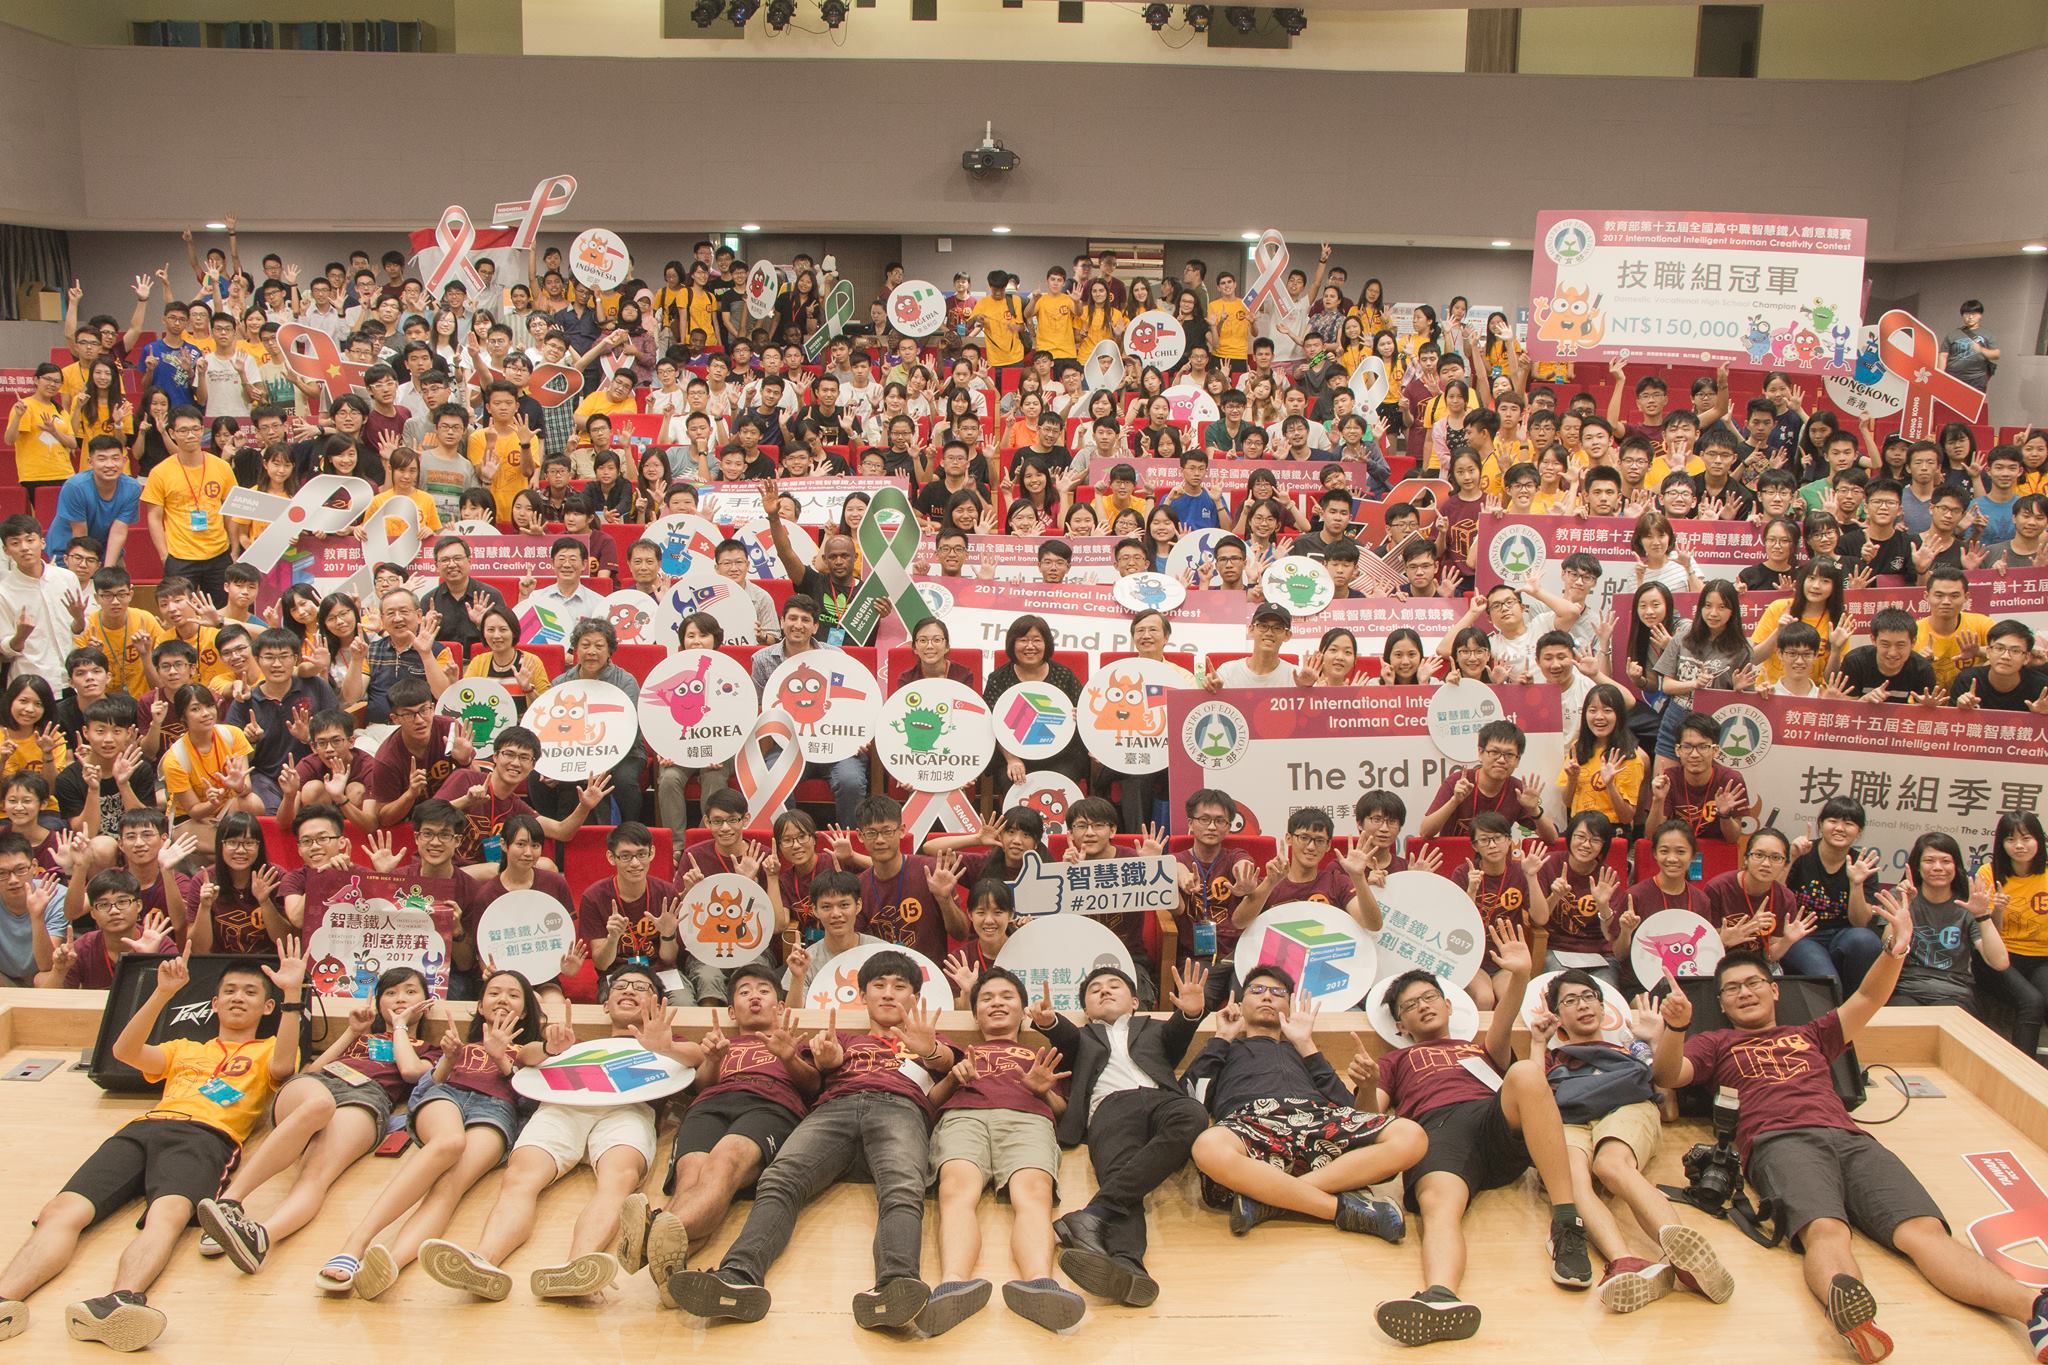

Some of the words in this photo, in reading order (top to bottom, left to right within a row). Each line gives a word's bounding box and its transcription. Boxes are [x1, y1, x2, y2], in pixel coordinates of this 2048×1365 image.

[1603, 234, 1623, 242] 2017
[1626, 234, 1681, 245] International
[1684, 236, 1727, 247] Intelligent
[1730, 238, 1767, 248] Ironman
[1770, 239, 1813, 250] Creativity
[1816, 241, 1851, 251] Contest
[1617, 260, 1799, 295] 技職組冠軍
[1752, 300, 1797, 312] Champion
[1612, 316, 1739, 338] NT$150,000
[509, 452, 521, 465] 15
[206, 483, 218, 495] 15
[1555, 527, 1635, 543] 教育部第十五
[1675, 532, 1764, 547] 高中職智慧鐵人
[323, 548, 361, 560] 教育部
[473, 546, 549, 559] 智慧鐵人創意
[1555, 544, 1577, 554] 2017
[1580, 545, 1633, 556] Internation
[1734, 551, 1769, 560] Creativi
[323, 563, 345, 572] 2017
[405, 563, 436, 574] Intellig
[493, 562, 536, 573] Creativity
[974, 585, 1006, 594] 2017
[1009, 587, 1092, 600] International
[1024, 599, 1078, 611] Ironman
[1083, 601, 1135, 615] Creativi
[1162, 607, 1201, 618] ontest
[1990, 595, 2044, 608] ernational
[850, 597, 875, 628] NIGERIA
[863, 608, 874, 622] 2017
[1318, 607, 1455, 622] 中職智慧鐵人創意競賽
[1112, 634, 1199, 654] Plce
[201, 652, 215, 664] 15
[1271, 697, 1305, 711] 2017
[1309, 696, 1402, 710] International
[1329, 714, 1390, 729] Ironman
[1450, 722, 1484, 735] 創意競
[820, 723, 866, 737] CHILE
[1185, 707, 1203, 755] MINISTRY
[1203, 704, 1217, 713] OF
[1218, 704, 1247, 753] EDUCATION
[1730, 706, 1742, 716] OF
[1744, 708, 1770, 758] EDUCATION
[808, 741, 834, 755] 智利
[1125, 736, 1168, 749] TAIWA
[1783, 728, 1811, 740] 2017
[1814, 733, 1888, 747] International
[1891, 738, 1951, 752] Intelligent
[1954, 741, 2003, 755] Ironman
[541, 744, 620, 758] NDONESIA
[688, 745, 713, 758] 韓國
[890, 753, 981, 767] SINGAPORE
[1196, 751, 1238, 768] 教育部
[1714, 751, 1759, 767] 教育部
[434, 763, 449, 777] 15
[560, 761, 587, 773] 印尼
[918, 769, 955, 782] 新加坡
[1287, 761, 1347, 791] The
[1358, 759, 1410, 789] 3rd
[1798, 765, 2045, 818] 技職組季軍
[953, 803, 977, 834] SINGAP
[1704, 804, 1718, 818] 15
[1961, 826, 1979, 836] The
[1066, 860, 1174, 891] 智慧鐵人
[1214, 881, 1228, 897] 15
[1071, 889, 1172, 912] #2017IICC
[1504, 892, 1519, 906] 15
[1581, 898, 1596, 912] 15
[2033, 895, 2048, 911] 15
[902, 902, 919, 918] 15
[330, 911, 396, 931] 智慧鐵人
[545, 917, 562, 926] 2017
[641, 920, 655, 934] 15
[488, 924, 546, 942] 智慧鐵人
[1943, 930, 1960, 945] 15
[362, 931, 430, 951] 創意競賽
[506, 937, 562, 957] 創意競賽
[1449, 934, 1472, 950] 2017
[387, 952, 414, 963] 2017
[1326, 979, 1346, 990] 2017
[756, 1056, 773, 1064] 2017
[644, 1071, 666, 1083] 2017
